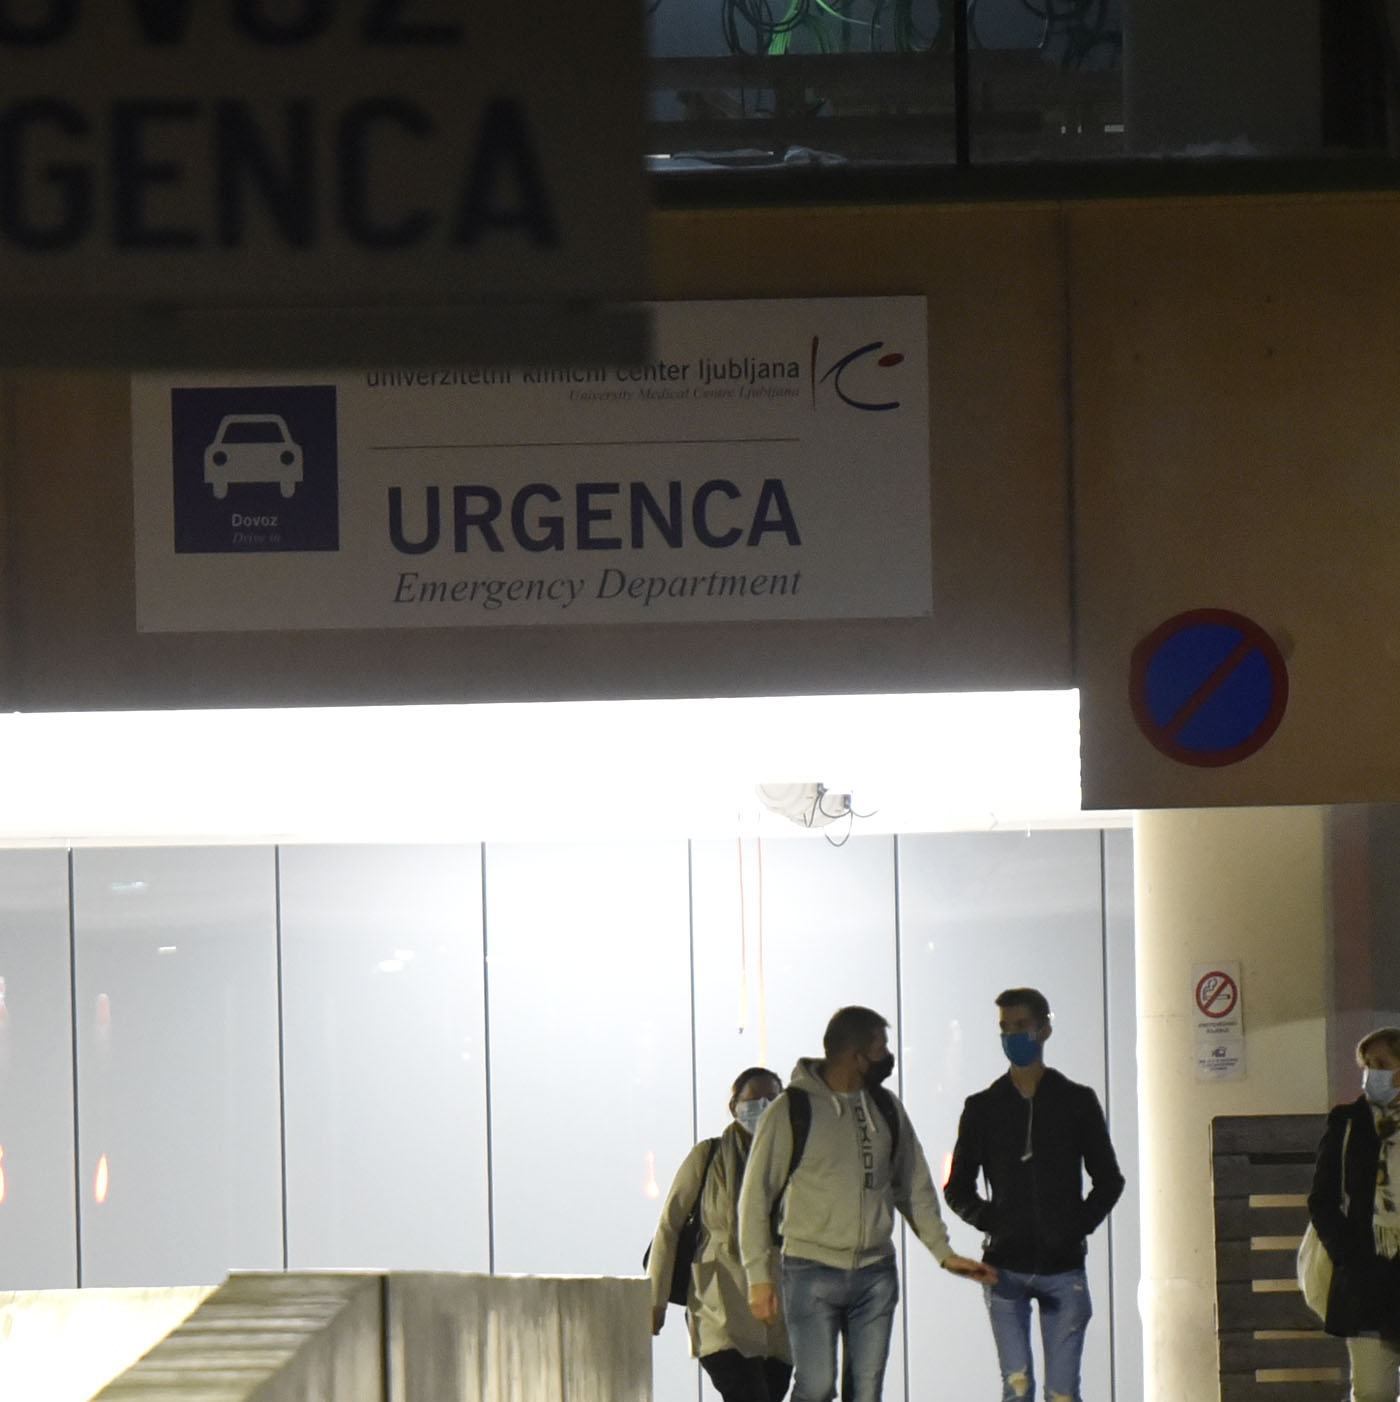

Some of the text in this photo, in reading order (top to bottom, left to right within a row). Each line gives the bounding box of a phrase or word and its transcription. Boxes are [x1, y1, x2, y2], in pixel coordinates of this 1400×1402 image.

[616, 360, 689, 382] center
[699, 357, 801, 385] ljubljana
[231, 513, 279, 527] Dovoz
[388, 479, 803, 555] URGENCA
[393, 567, 803, 611] Emergency Department
